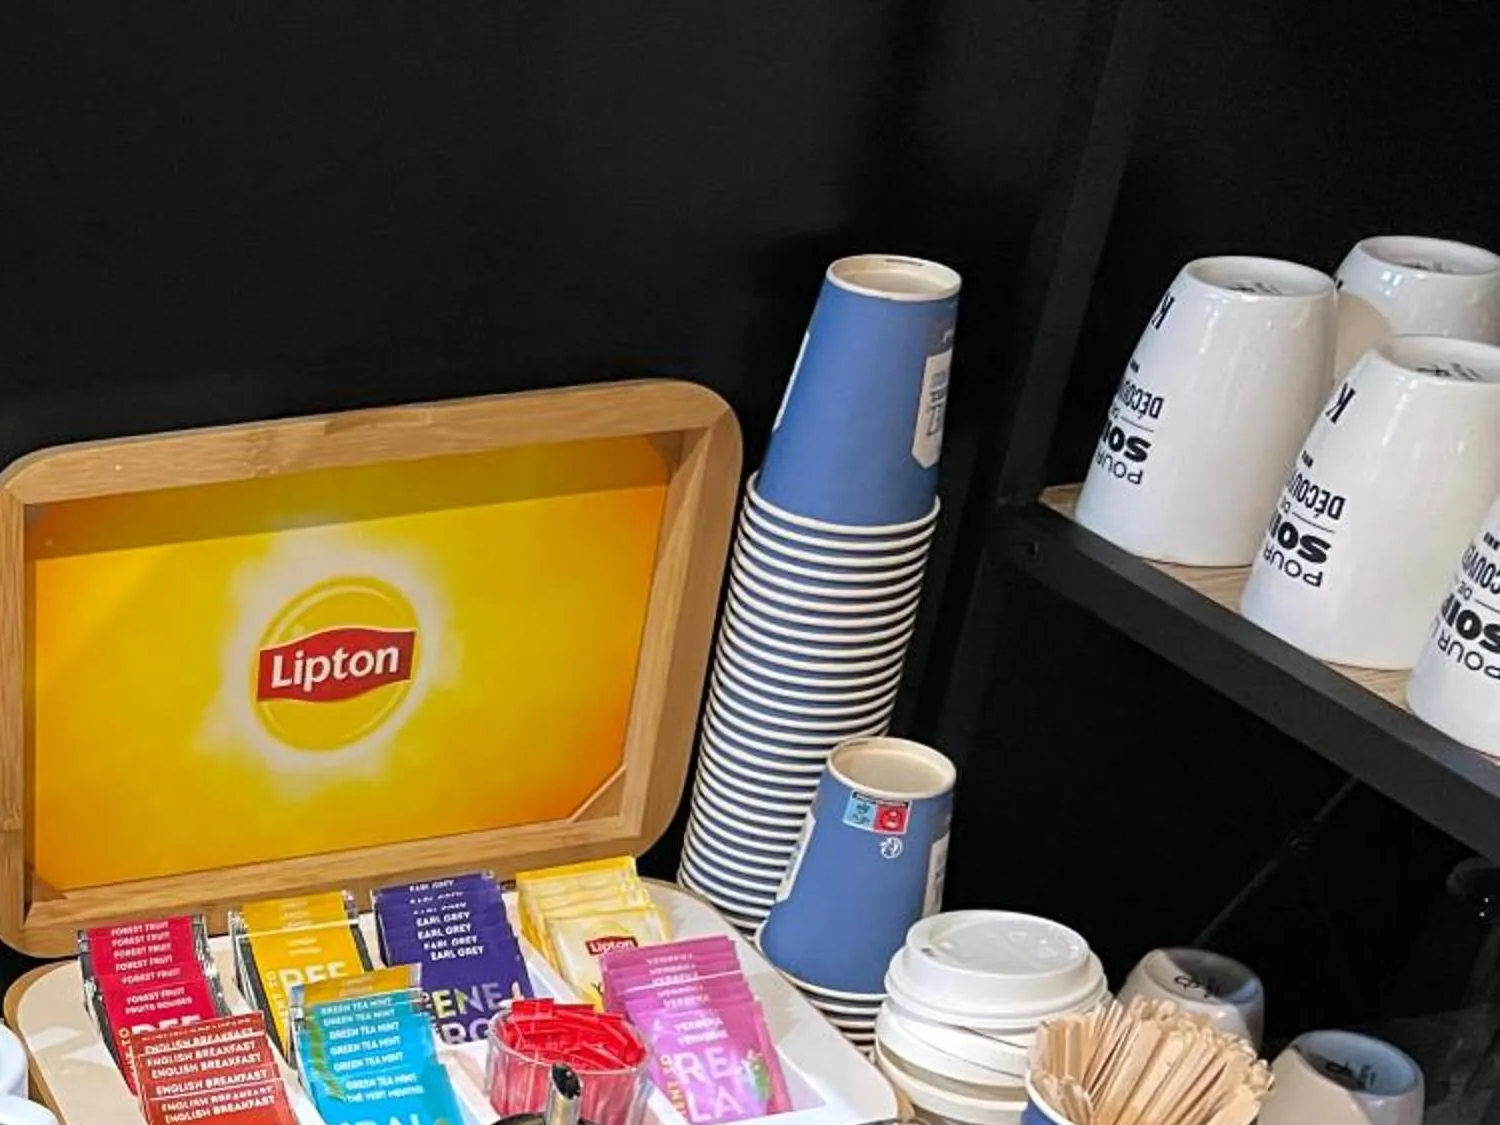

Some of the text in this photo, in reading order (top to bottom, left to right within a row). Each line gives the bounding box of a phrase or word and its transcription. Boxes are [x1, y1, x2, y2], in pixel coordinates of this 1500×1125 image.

[1326, 382, 1356, 424] K
[1263, 543, 1323, 588] POUR
[271, 646, 399, 692] Lipton
[417, 912, 470, 926] EARL GREY
[111, 921, 168, 936] FOREST FRUIT
[418, 924, 471, 939] EARL GREY
[112, 932, 170, 947] FOREST FRUIT
[423, 935, 477, 950] EARL GREY
[114, 943, 171, 959] FOREST FRUIT
[431, 946, 484, 961] EARL GREY
[116, 955, 173, 971] FOREST FRUIT
[122, 968, 181, 984] FOREST FRUIT
[127, 987, 185, 1004] FOREST FRUIT
[329, 1021, 399, 1039] GREEN TEA MINT
[674, 1017, 724, 1031] VERBENA
[147, 1053, 192, 1066] ENGLISH
[196, 1041, 255, 1059] BREAKFAST
[329, 1036, 401, 1055] GREEN TEA MINT
[152, 1053, 261, 1079] ENGLISH BREAKFAST
[334, 1051, 403, 1071] GREEN TEA MINT
[156, 1069, 267, 1095] ENGLISH BREAKFAST
[345, 1072, 417, 1089] GREEN TEA MINT
[162, 1086, 272, 1111] ENGLISH BREAKFAST
[165, 1096, 275, 1124] ENGLISH BREAKFAST
